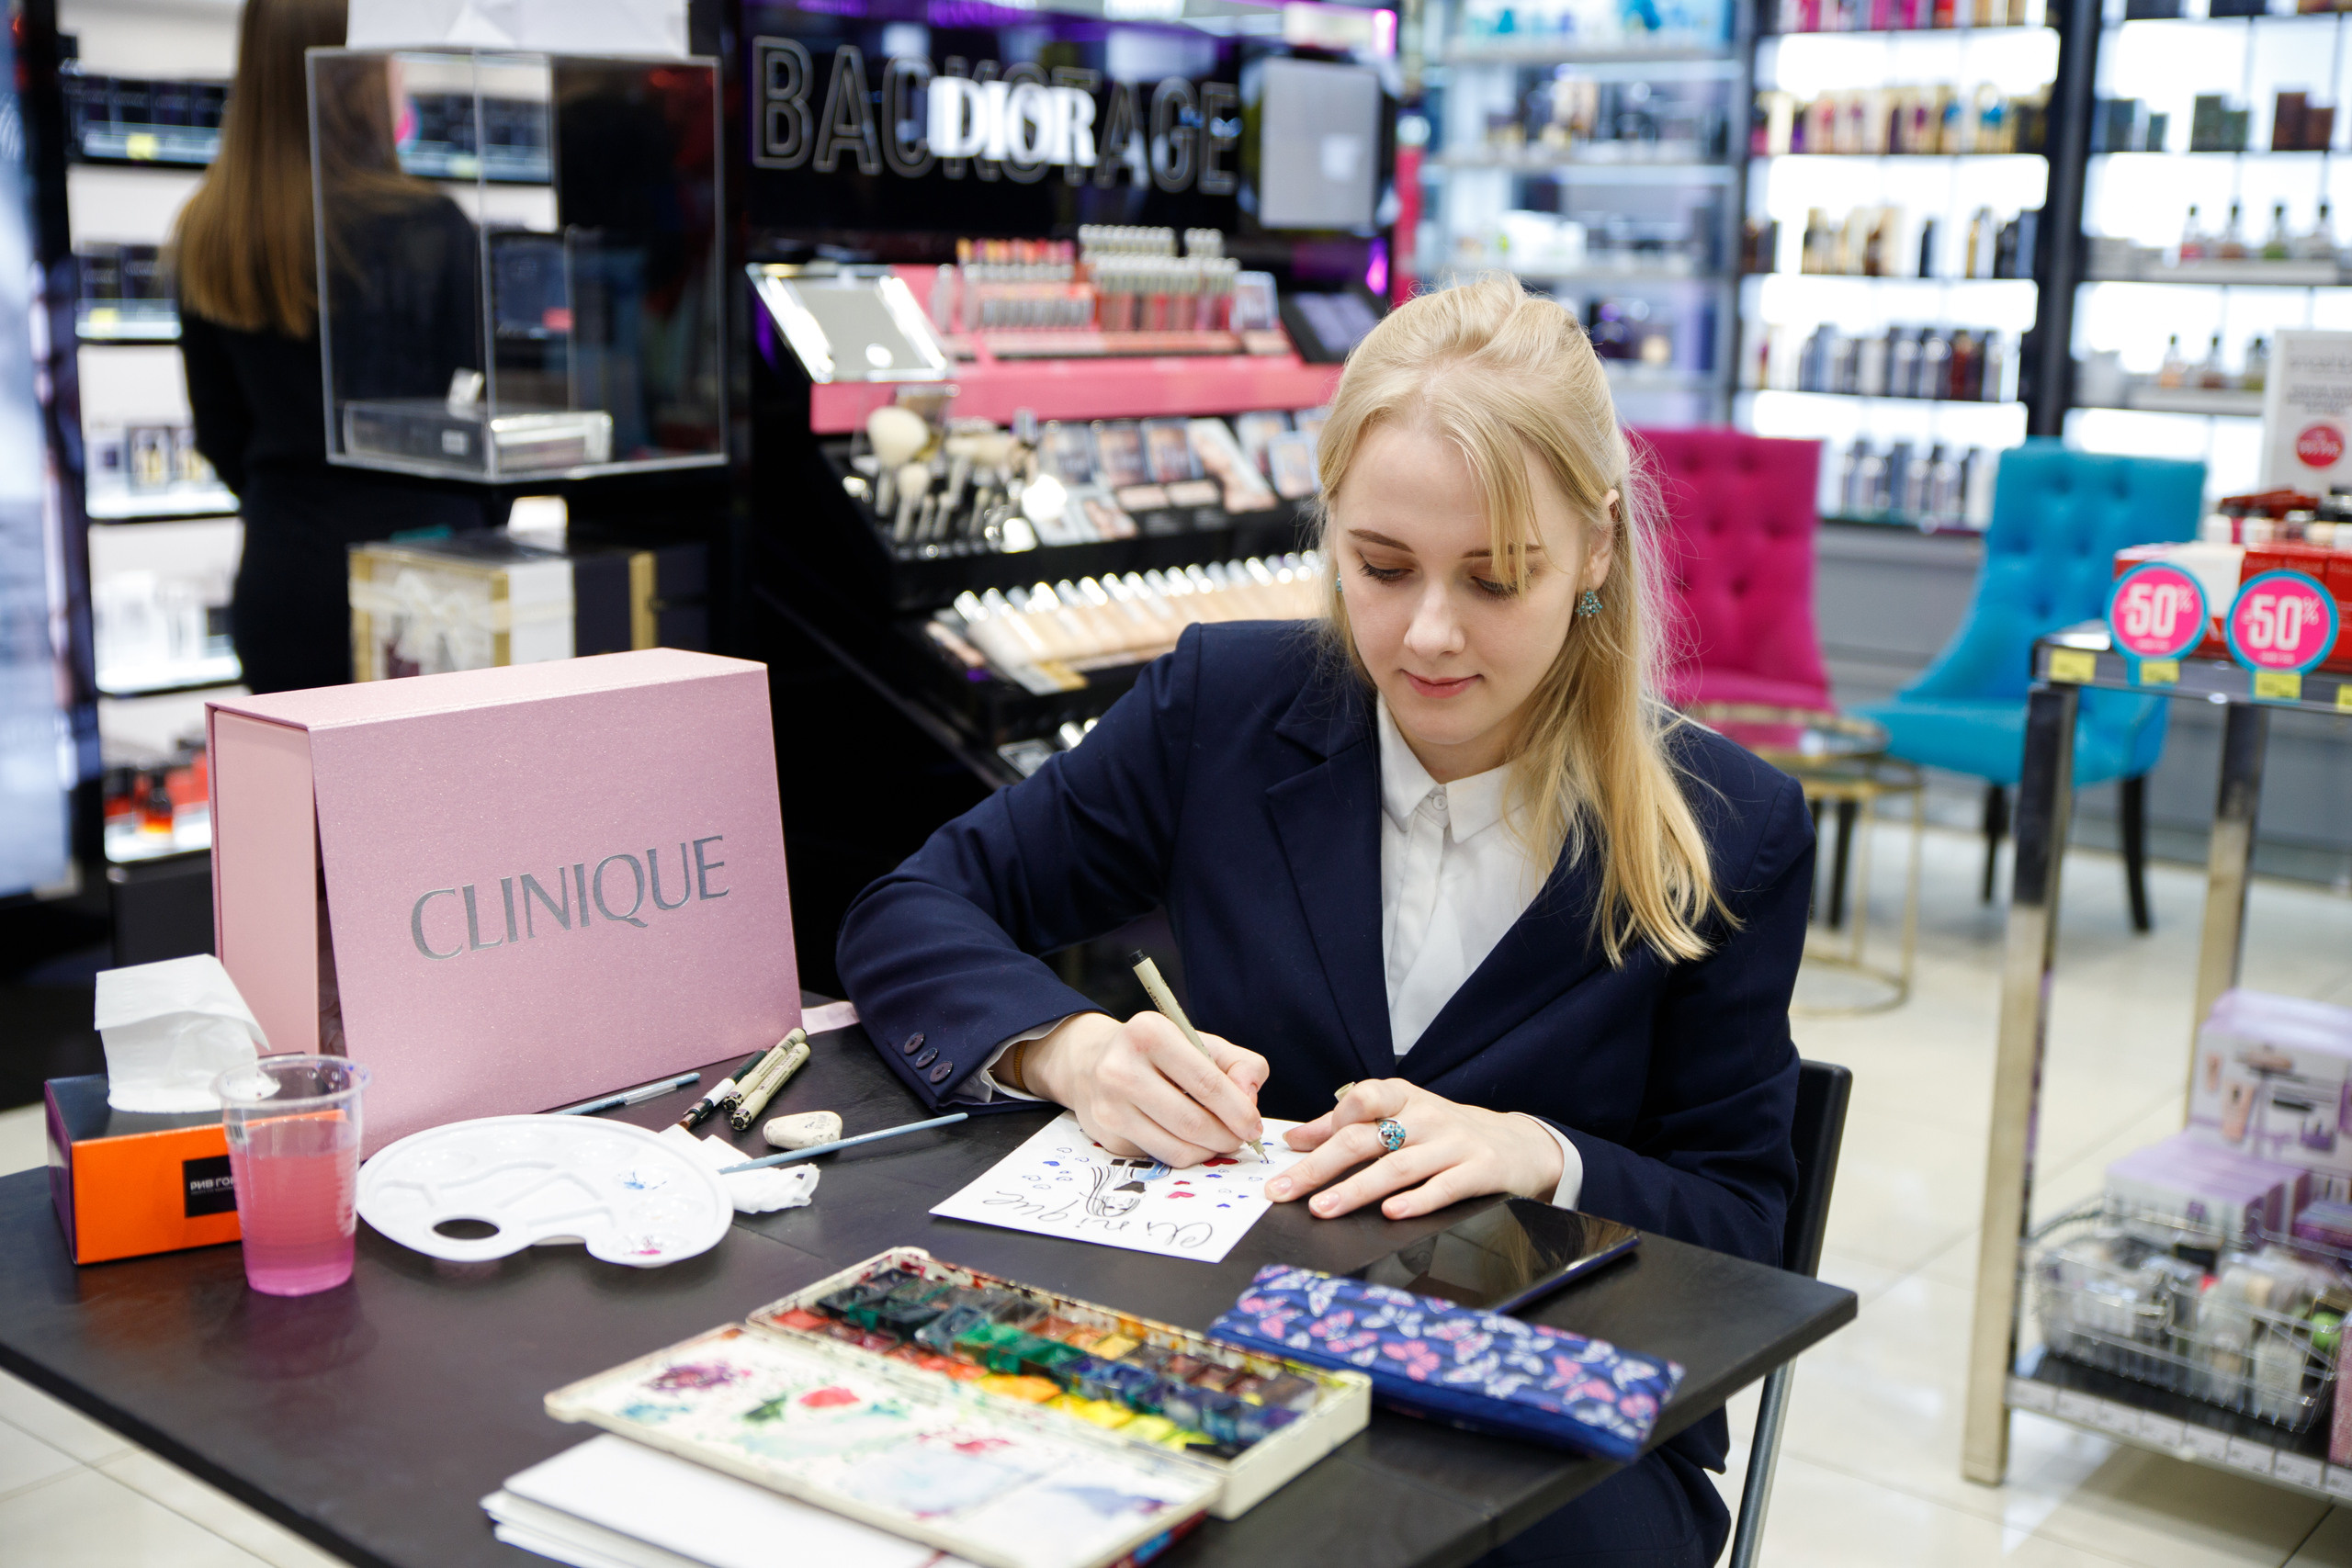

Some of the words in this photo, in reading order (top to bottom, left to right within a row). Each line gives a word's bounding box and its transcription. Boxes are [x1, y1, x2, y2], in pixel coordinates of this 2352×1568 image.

[927, 74, 1097, 166] DIOR
[411, 834, 729, 961] CLINIQUE
[982, 1190, 1213, 1249] Clinique
